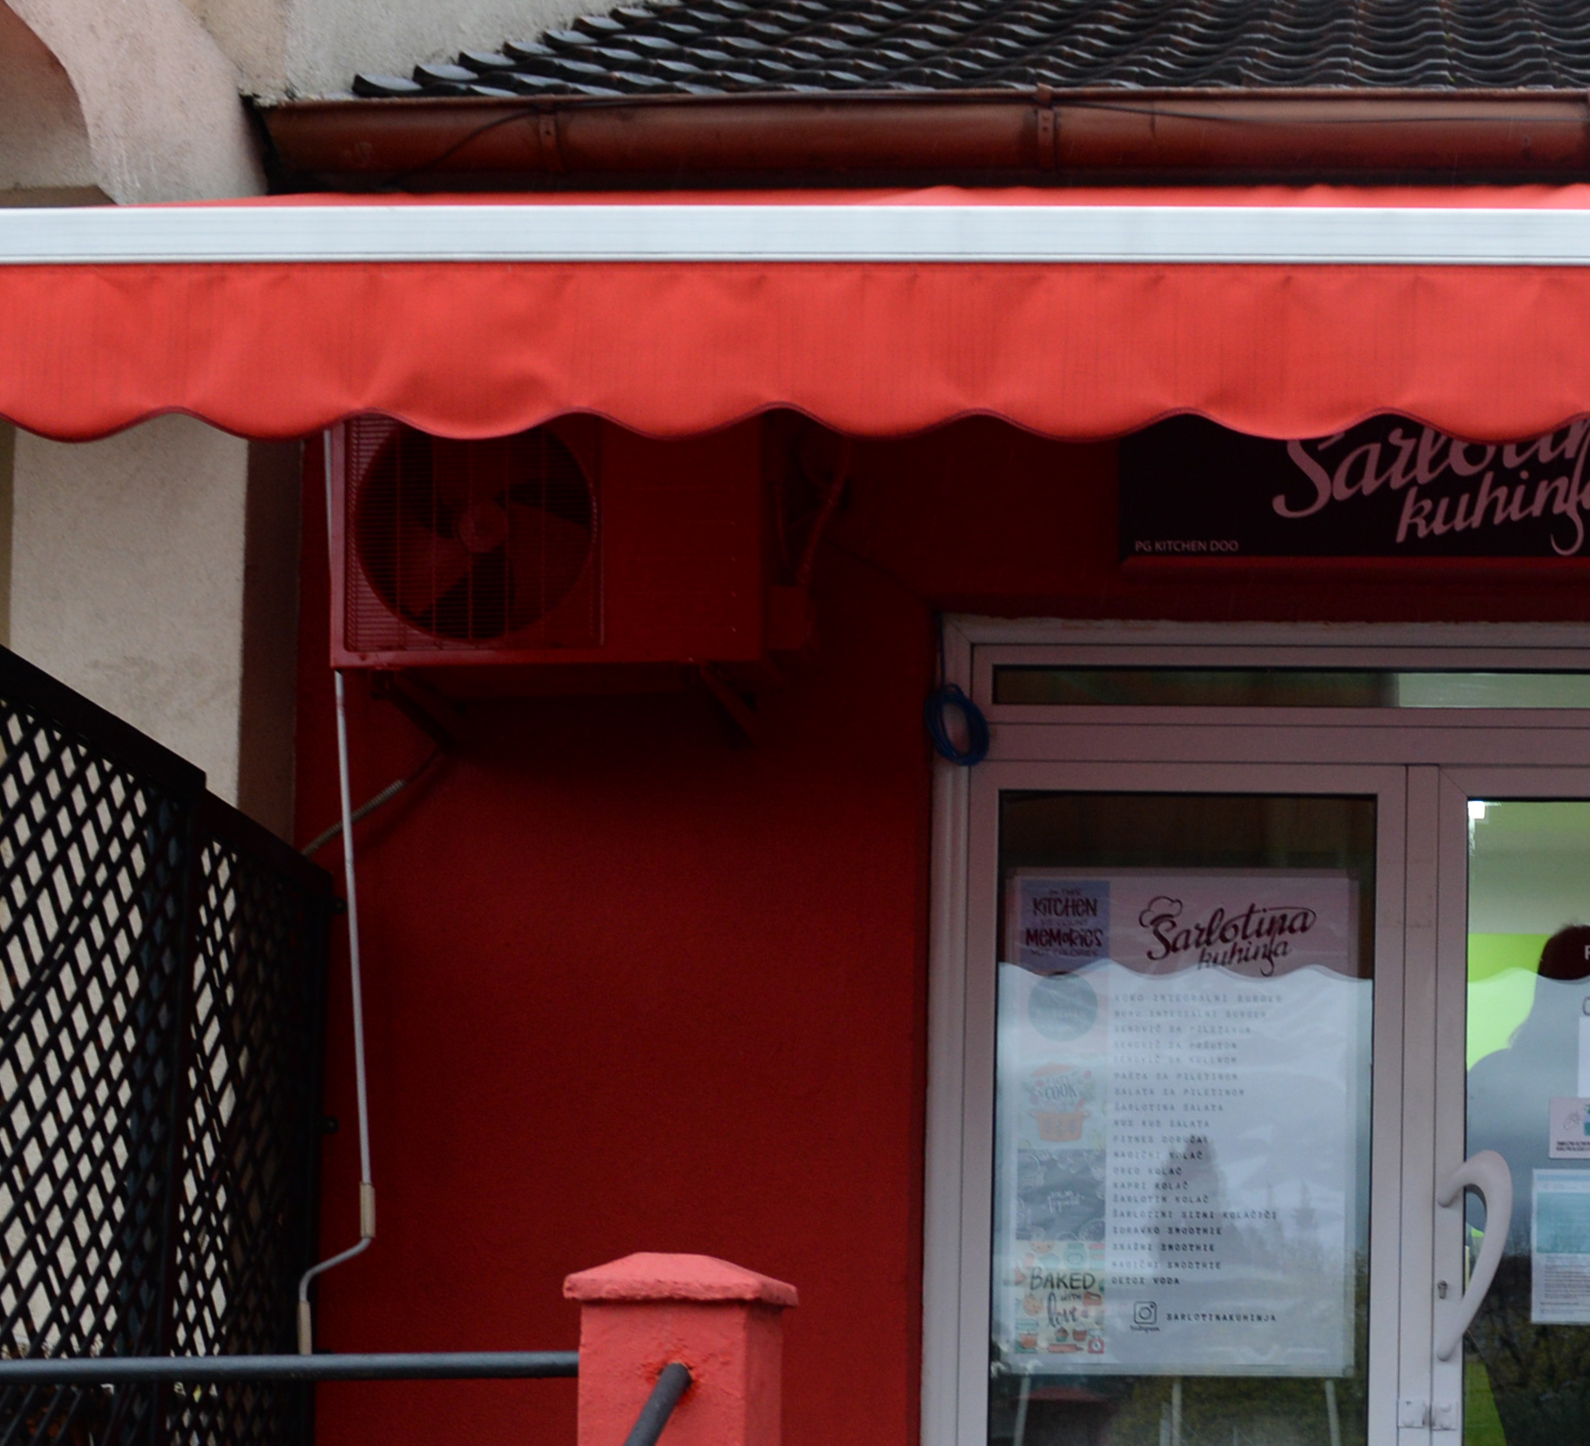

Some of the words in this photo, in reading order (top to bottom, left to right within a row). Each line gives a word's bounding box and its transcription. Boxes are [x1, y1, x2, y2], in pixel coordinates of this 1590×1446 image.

[1134, 540, 1152, 552] PG
[1154, 540, 1208, 552] KITCHEN
[1209, 540, 1240, 552] DOO
[1196, 939, 1293, 977] kuhinja
[1029, 1265, 1096, 1291] BAKED
